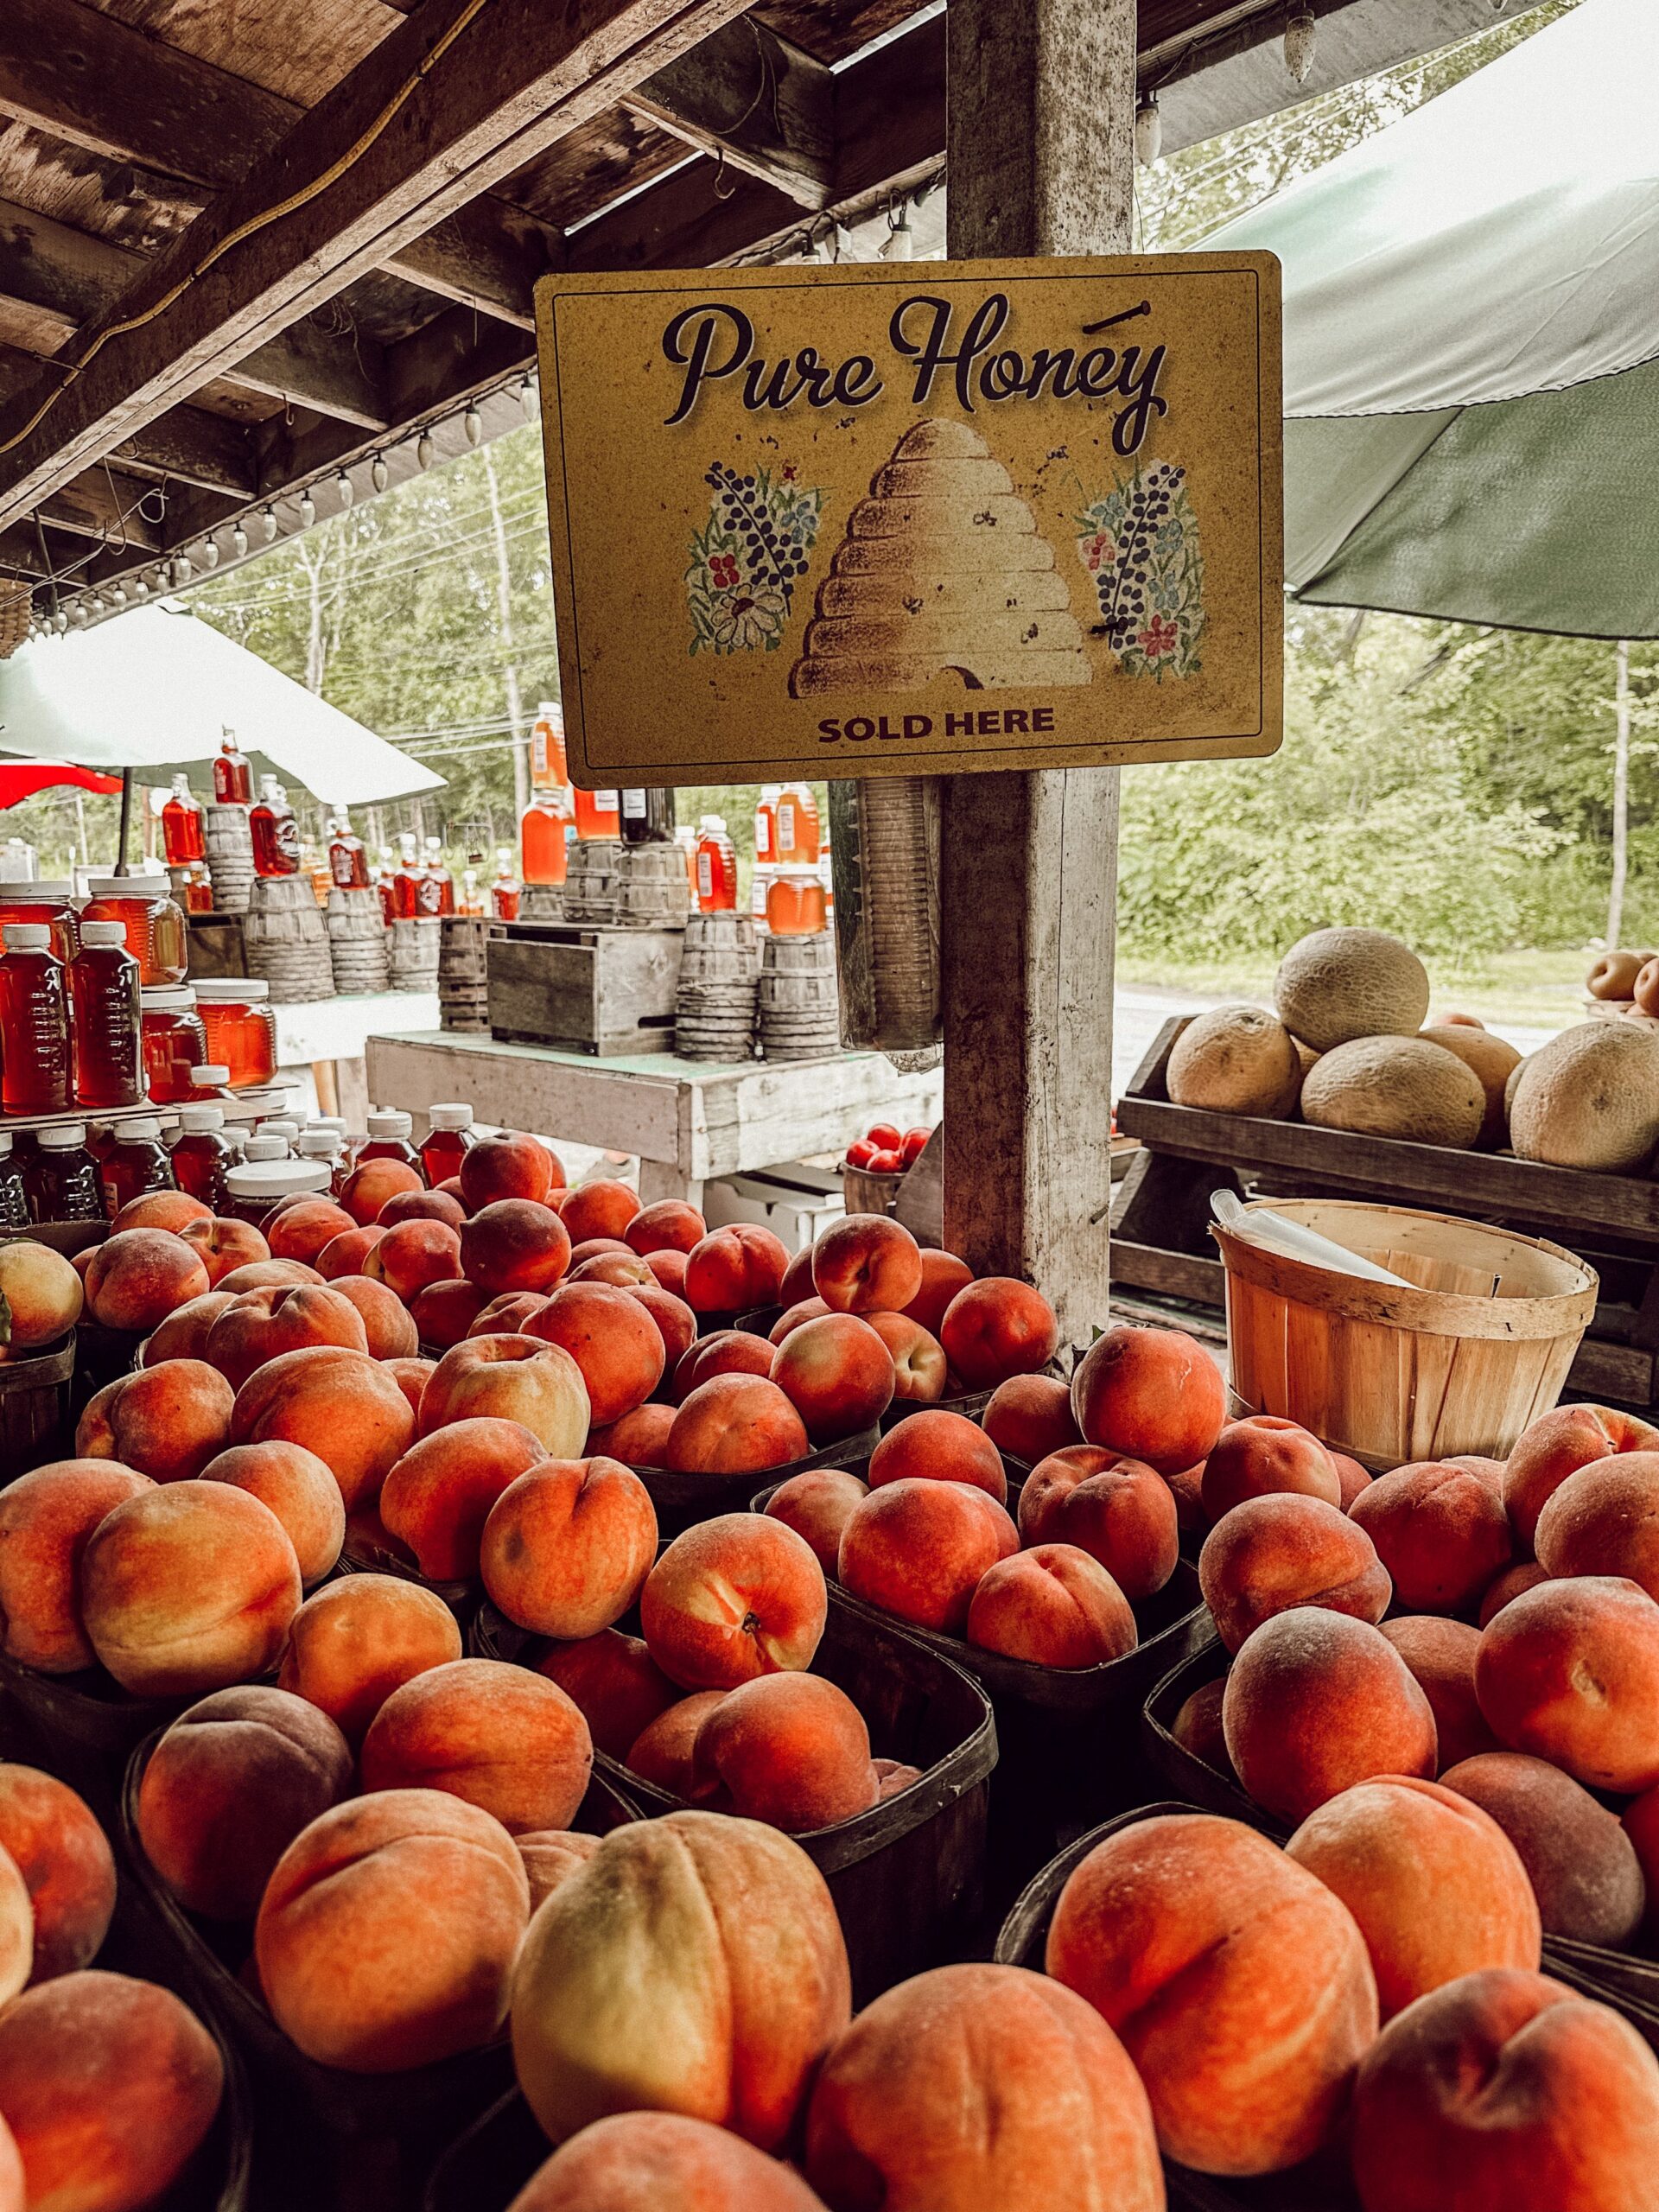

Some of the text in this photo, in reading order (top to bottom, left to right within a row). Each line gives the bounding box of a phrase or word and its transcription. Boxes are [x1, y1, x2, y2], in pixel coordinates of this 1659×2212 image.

[663, 294, 1167, 456] Pure Honey
[818, 708, 1054, 743] SOLD HERE
